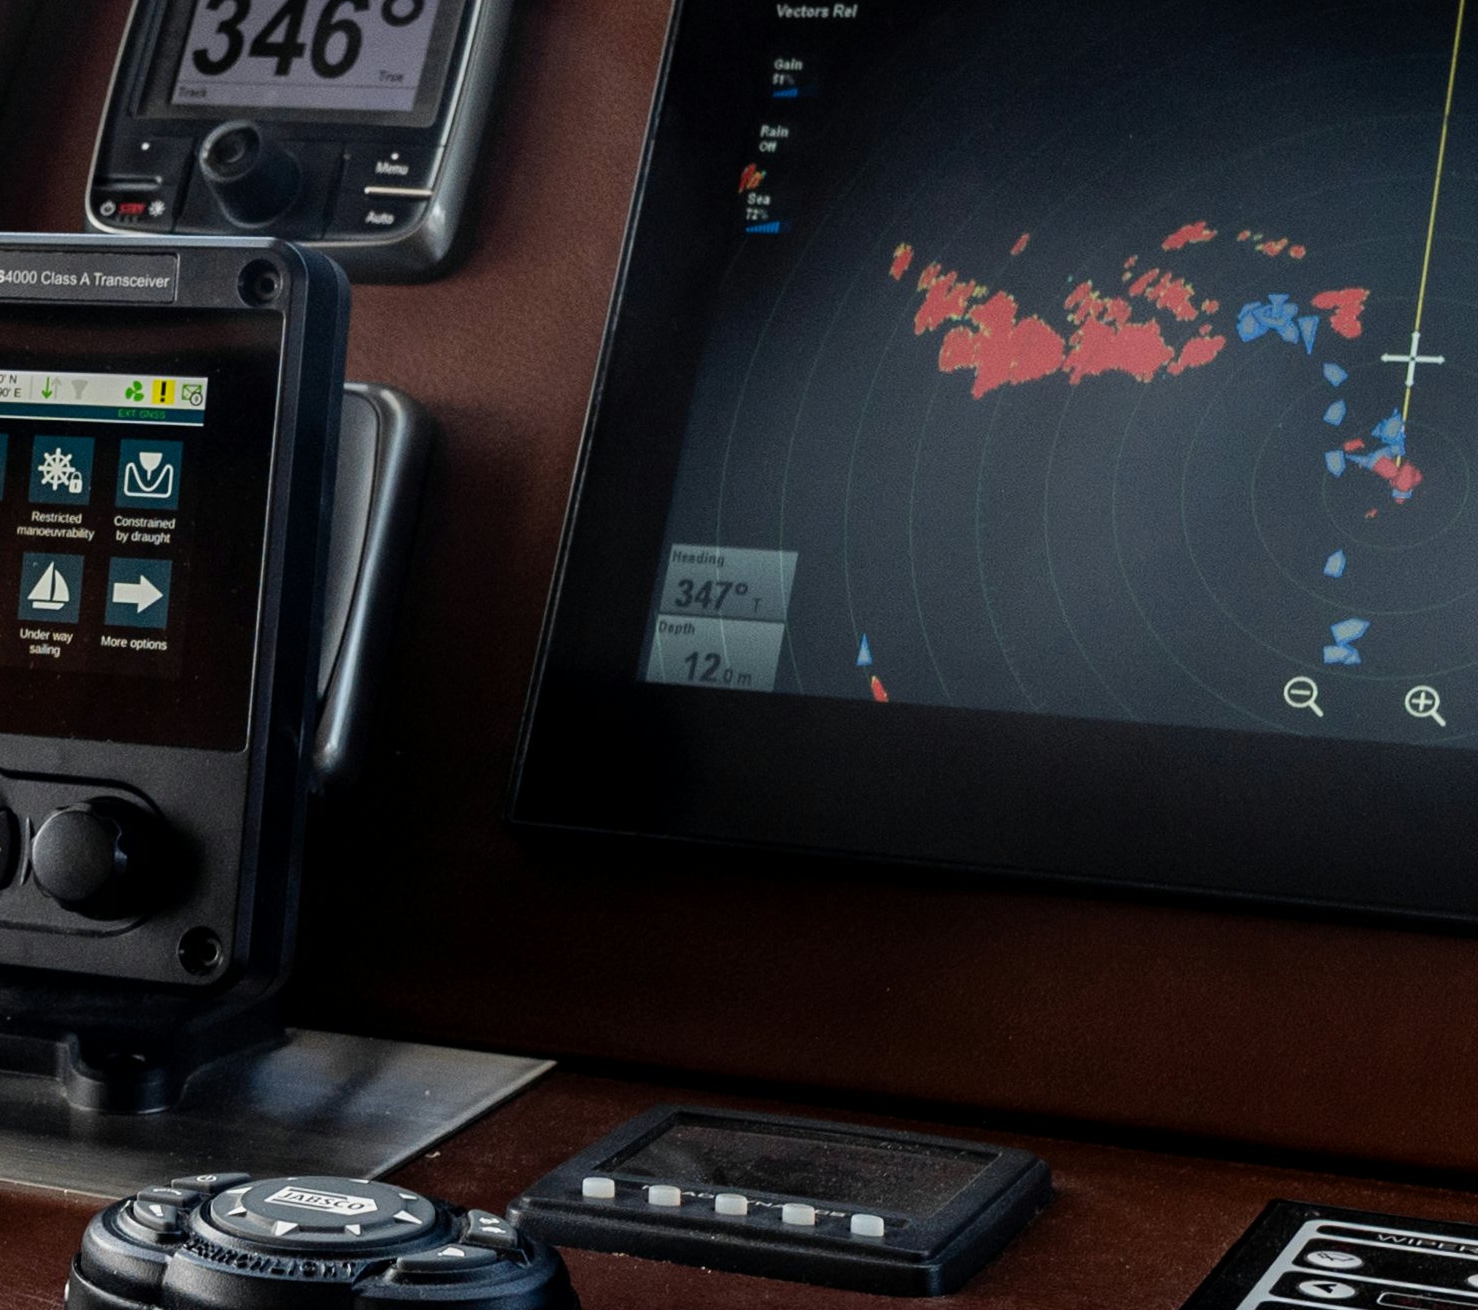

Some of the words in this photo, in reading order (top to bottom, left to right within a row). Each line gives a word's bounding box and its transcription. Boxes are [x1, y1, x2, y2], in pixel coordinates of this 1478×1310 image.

[776, 4, 829, 18] Vectors
[832, 4, 858, 18] Rel
[773, 58, 803, 71] Gain
[760, 124, 790, 138] Rain
[747, 192, 771, 205] Sea
[41, 271, 77, 286] Class
[80, 272, 91, 286] A
[94, 272, 170, 289] Transceiver
[9, 374, 18, 384] N
[13, 387, 22, 398] E
[118, 408, 137, 418] EXT
[31, 511, 82, 524] Restricted
[113, 515, 176, 530] Constrained
[16, 525, 95, 541] manoeuvrability
[115, 531, 128, 544] by
[130, 532, 171, 546] draught
[672, 549, 725, 568] Heading
[674, 578, 749, 611] 347°
[19, 628, 49, 641] Under
[52, 631, 74, 645] way
[658, 619, 696, 640] Depth
[29, 643, 61, 658] sailing
[100, 635, 128, 648] More
[130, 637, 168, 651] options
[736, 671, 752, 686] m
[278, 1191, 365, 1210] JABSCO
